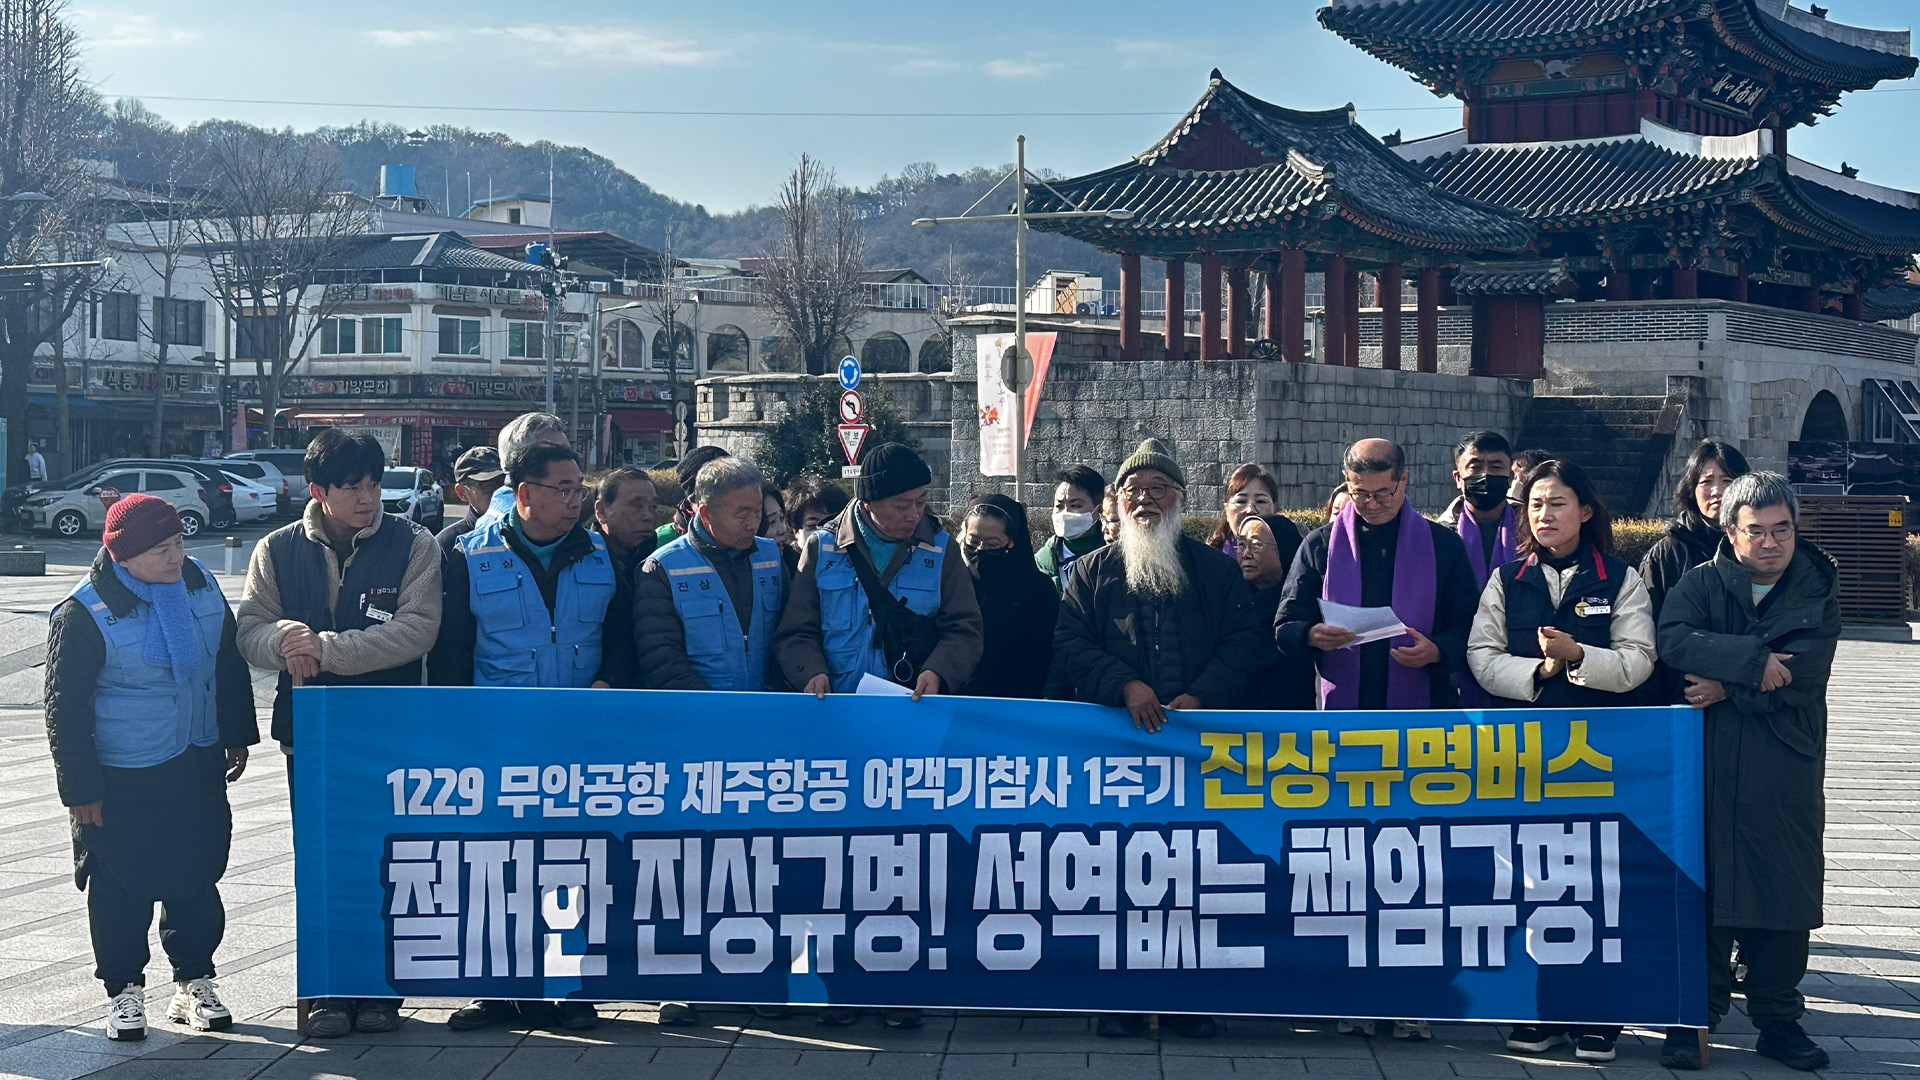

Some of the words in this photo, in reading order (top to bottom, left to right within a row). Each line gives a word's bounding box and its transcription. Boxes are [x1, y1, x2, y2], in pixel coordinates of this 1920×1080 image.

[479, 558, 514, 572] 진상
[677, 579, 710, 592] 진상
[386, 767, 484, 816] 1229
[497, 763, 670, 817] 무안공항
[681, 758, 849, 814] 제주항공
[863, 755, 1072, 810] 여객기참사
[1083, 756, 1185, 808] 1주기
[1200, 721, 1615, 809] 진상규명버스
[388, 837, 614, 980] 철저한
[632, 835, 948, 975] 진상규명!
[972, 829, 1266, 971] 성역없는
[1288, 821, 1622, 968] 책임규명!
